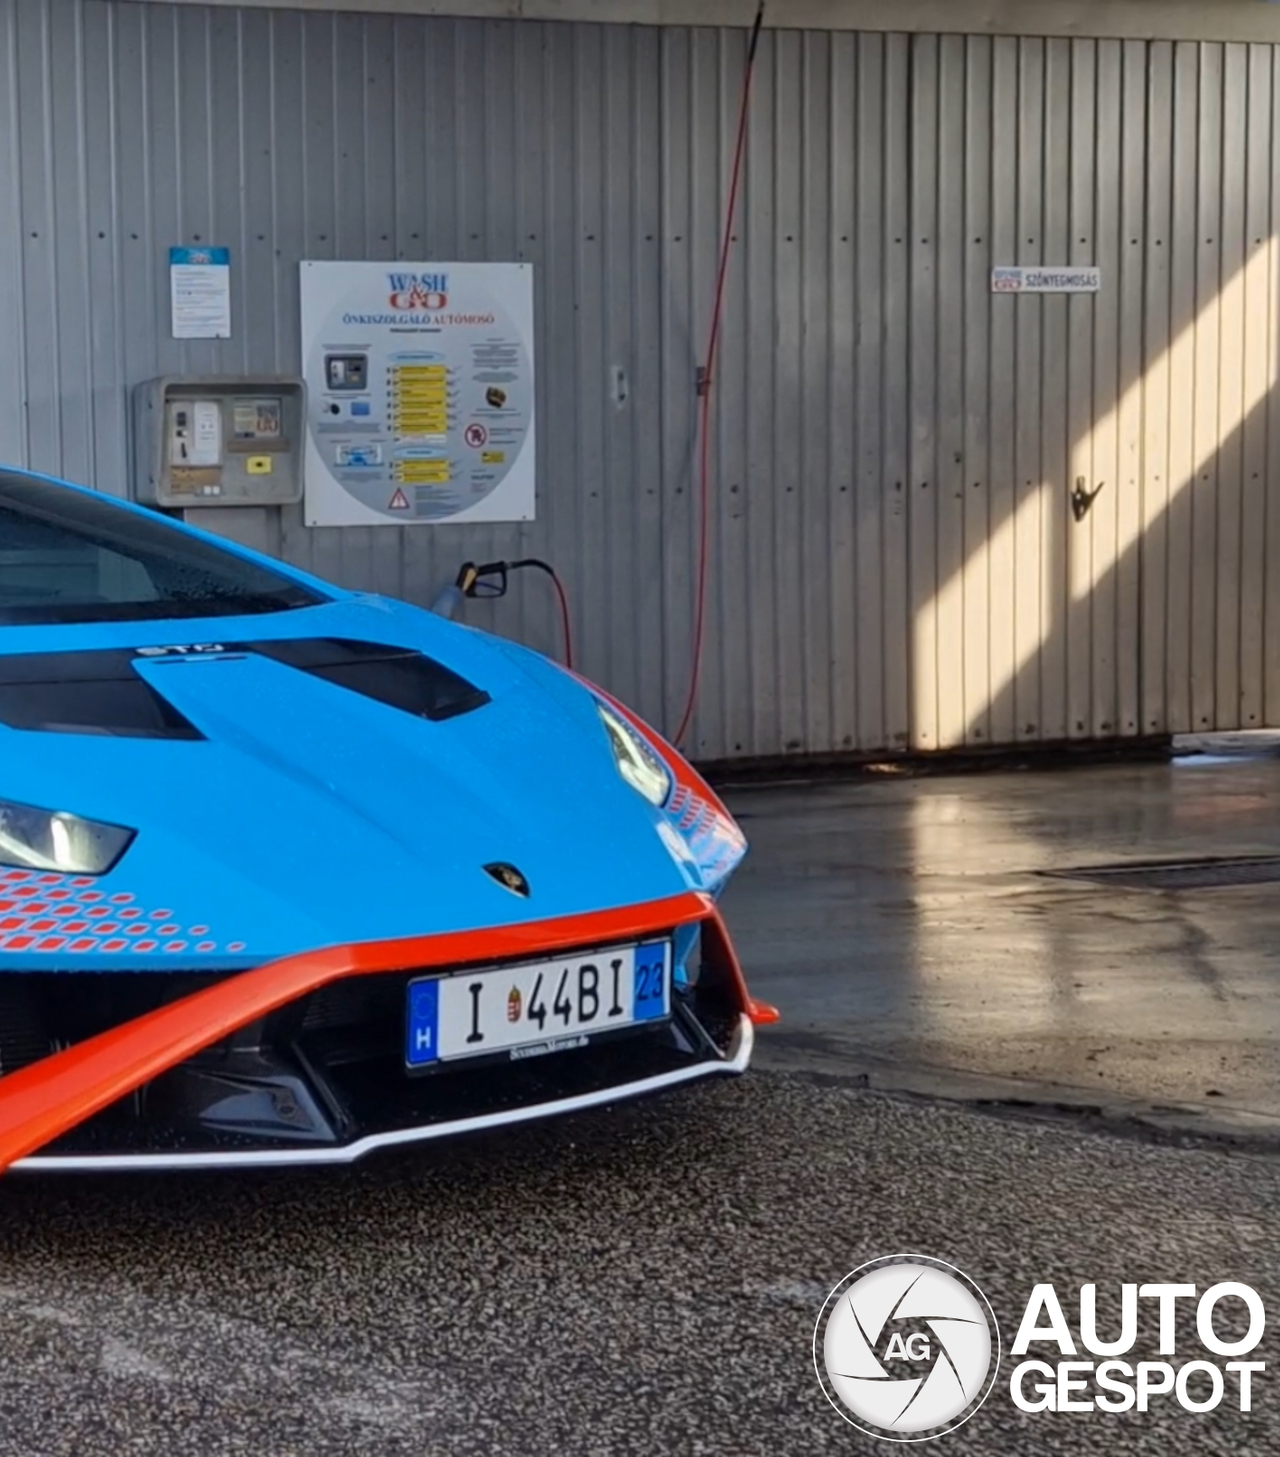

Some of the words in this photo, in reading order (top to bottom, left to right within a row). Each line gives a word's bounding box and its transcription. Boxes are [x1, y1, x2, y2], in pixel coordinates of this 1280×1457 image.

[388, 273, 448, 292] WASH
[389, 292, 448, 310] GO
[465, 982, 484, 1044] I
[526, 959, 624, 1031] 44BI
[635, 961, 664, 1001] 23
[415, 1026, 432, 1051] H
